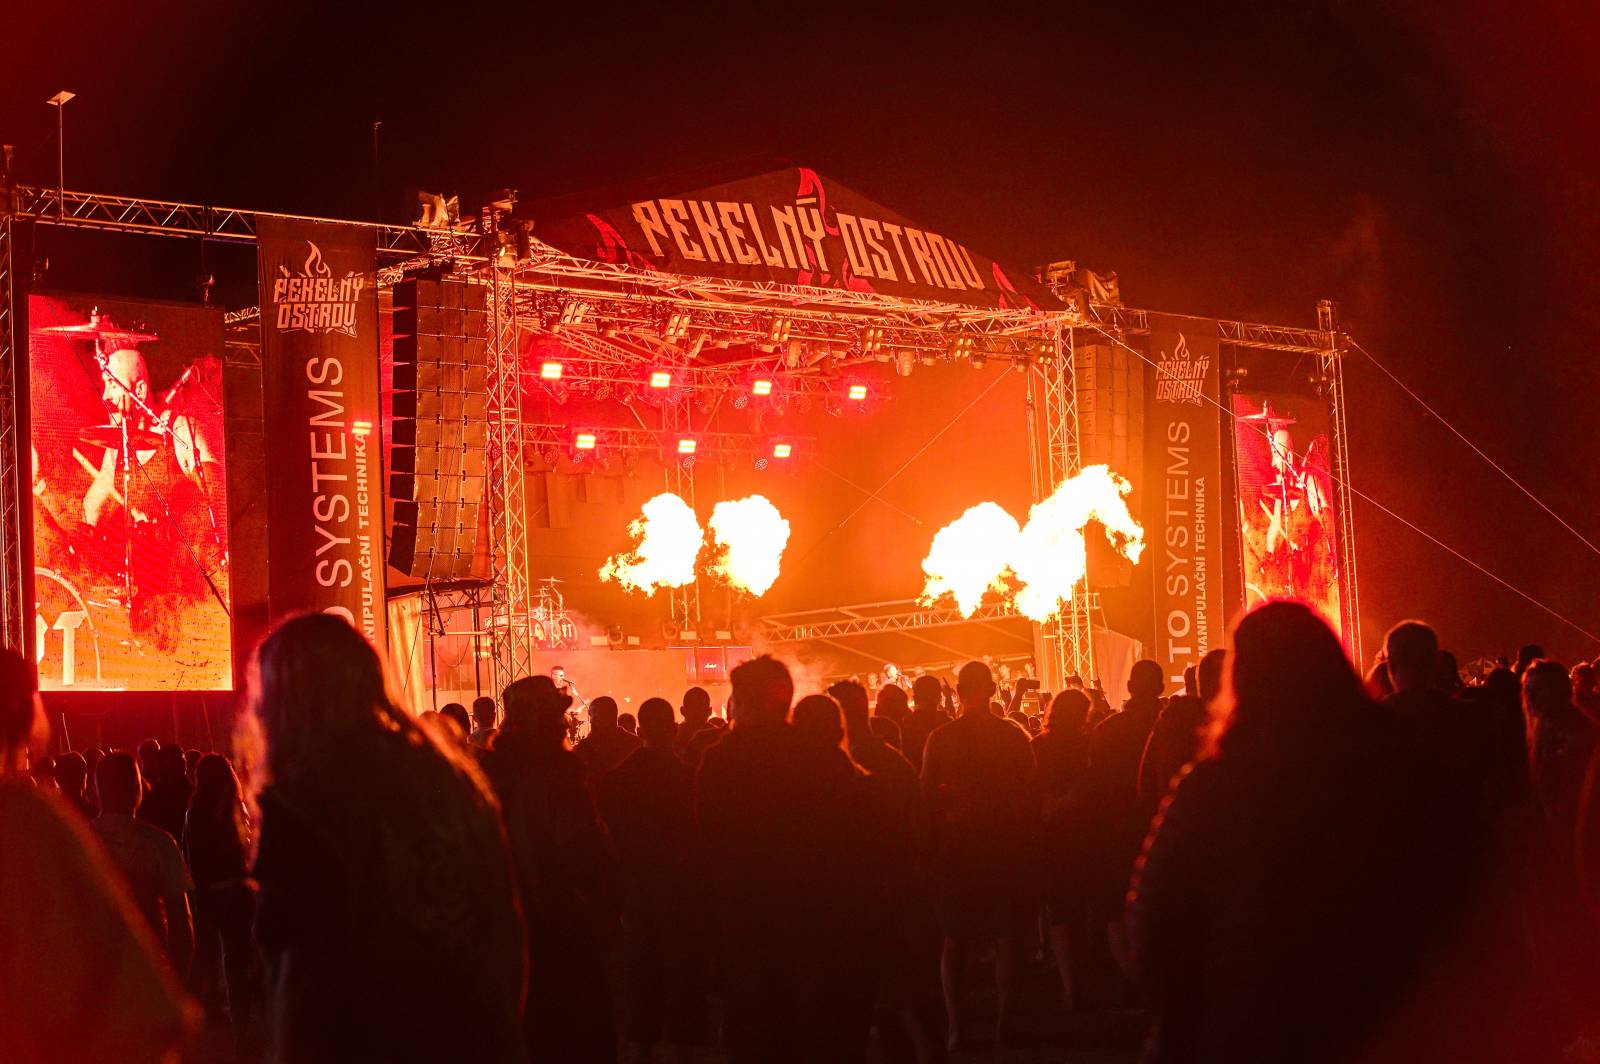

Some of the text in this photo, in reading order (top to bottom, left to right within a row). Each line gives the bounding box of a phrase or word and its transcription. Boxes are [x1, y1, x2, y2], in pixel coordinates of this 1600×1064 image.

[306, 357, 353, 588] SYSTEMS
[354, 432, 376, 642] NIPULAČNÍ TECHNIKA
[1165, 421, 1190, 596] SYSTEMS
[1193, 476, 1208, 657] MANIPULAČNÍ TECHNIKA
